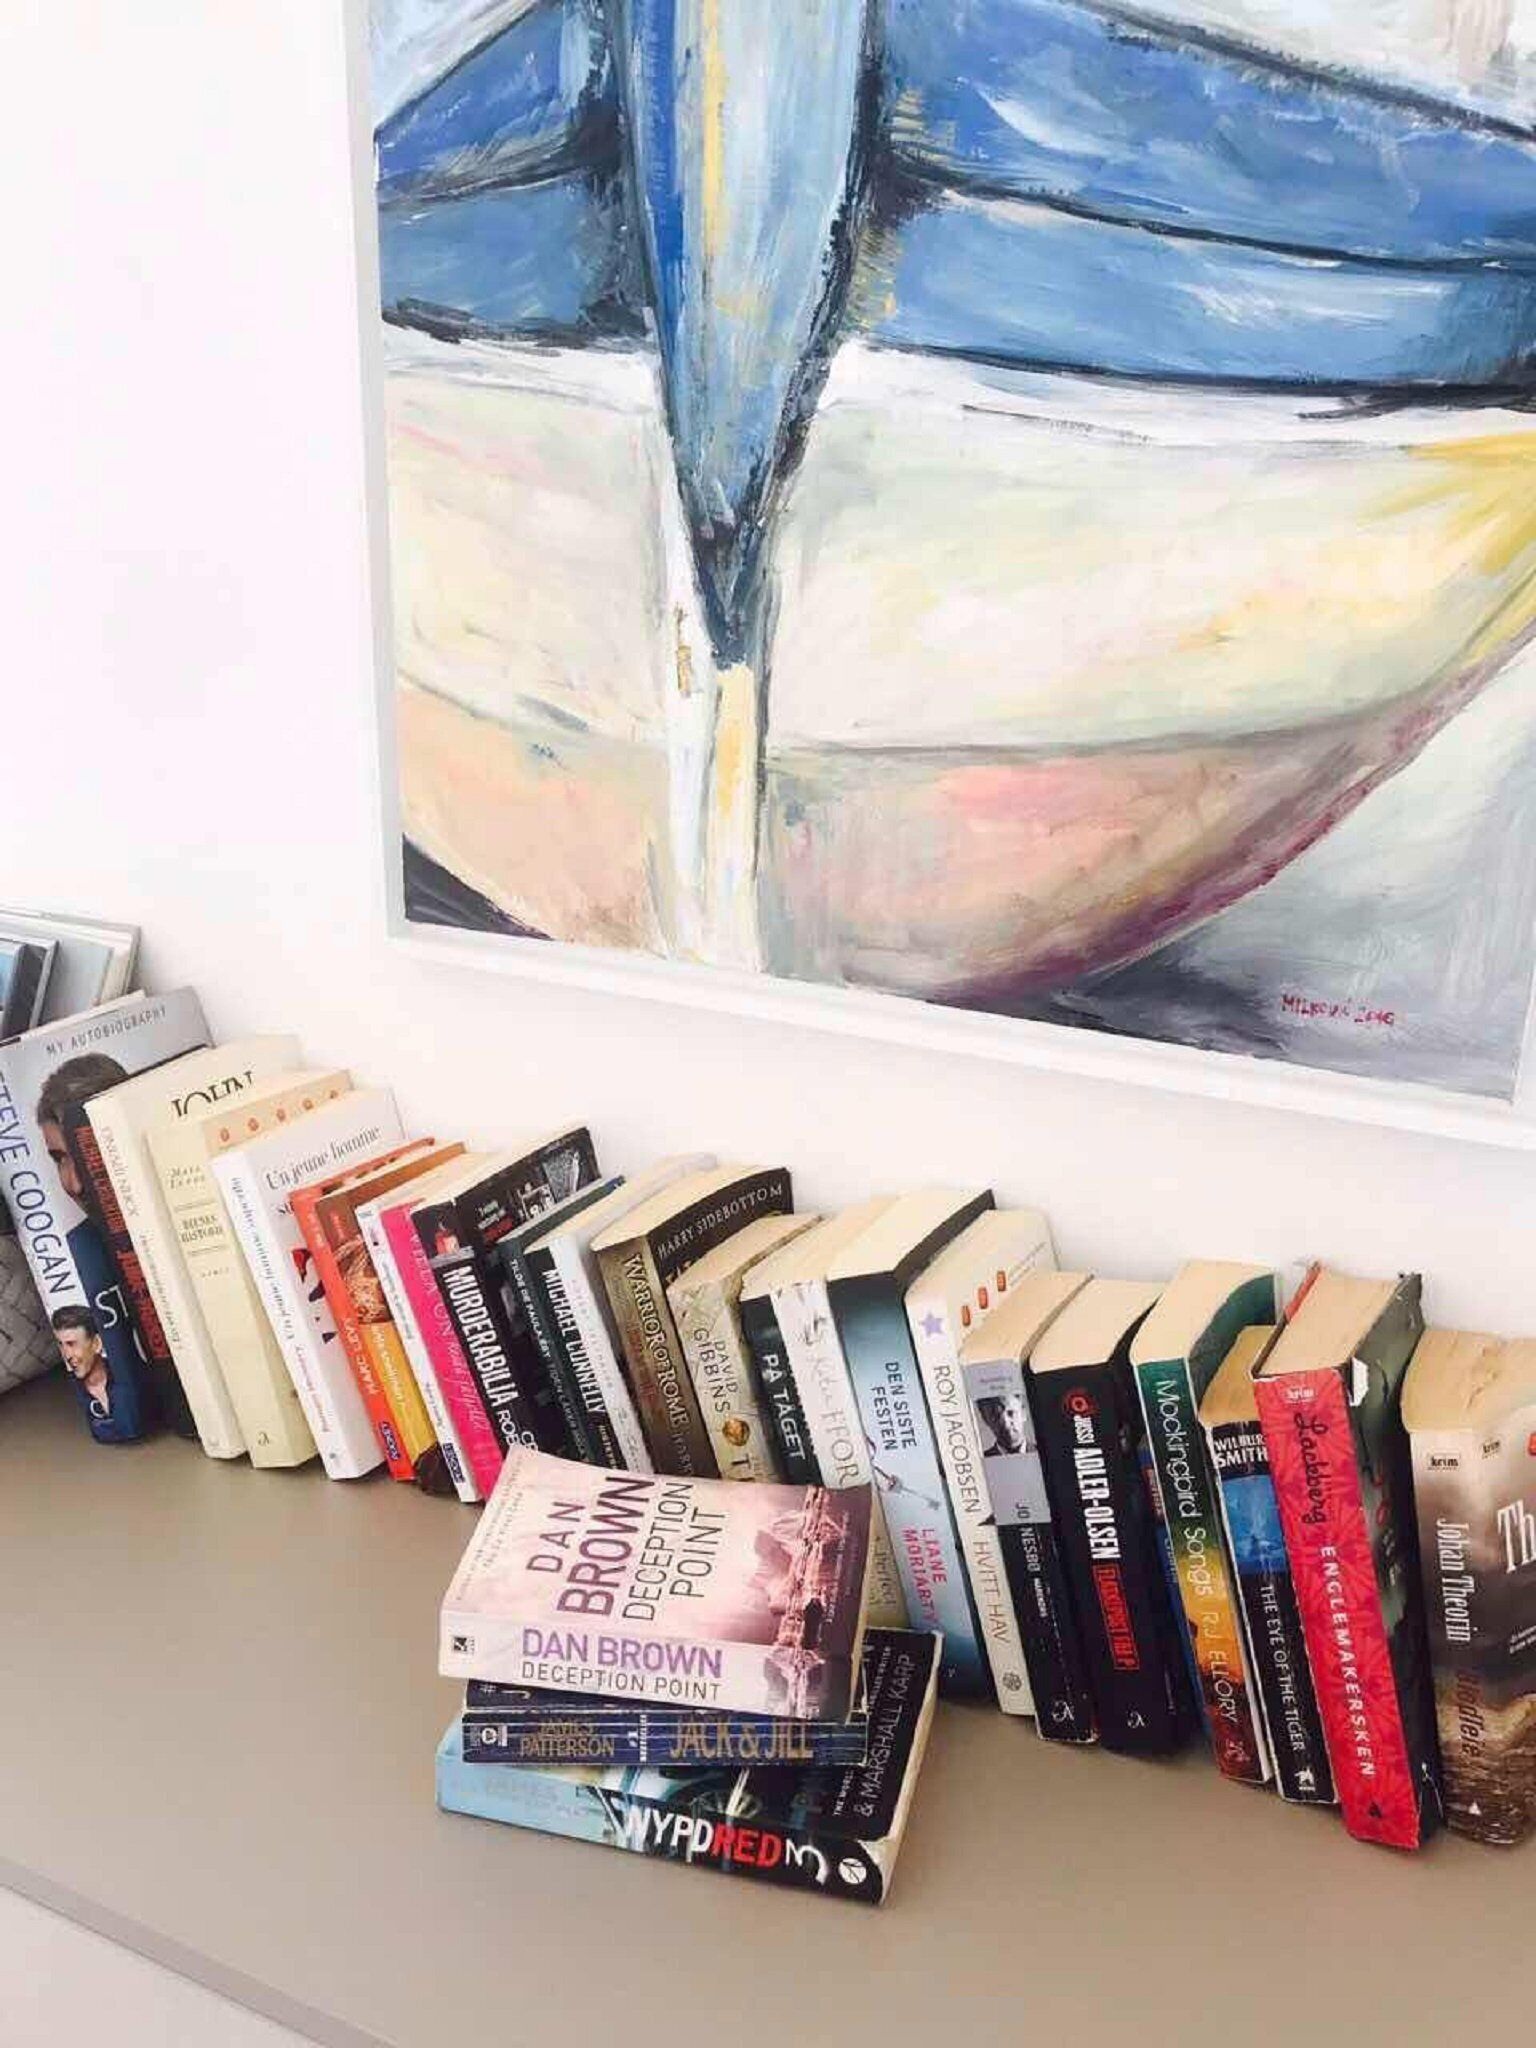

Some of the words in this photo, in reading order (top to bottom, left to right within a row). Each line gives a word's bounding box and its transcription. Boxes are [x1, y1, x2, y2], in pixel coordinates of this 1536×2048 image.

[46, 1043, 64, 1057] MY
[70, 1006, 167, 1049] AUTOBIOGRAPHY
[0, 1072, 30, 1164] TEVE
[10, 1169, 77, 1296] COOGAN
[657, 1224, 696, 1260] HARRY
[695, 1183, 783, 1235] SIDEBOTTOM
[510, 1259, 527, 1289] TILDE
[620, 1254, 667, 1351] WARRIOR
[443, 1265, 519, 1408] MURDERABILIA
[541, 1268, 574, 1338] MICHAEL
[565, 1337, 606, 1414] CONNELLY
[652, 1347, 670, 1368] OF
[693, 1327, 731, 1413] GIBBINS
[714, 1340, 738, 1394] DAVID
[885, 1361, 903, 1396] DEN
[933, 1364, 957, 1405] ROY
[657, 1366, 689, 1427] ROME
[871, 1386, 898, 1451] FESTEN
[893, 1399, 917, 1449] SISTE
[1213, 1433, 1266, 1452] WILBUR
[941, 1410, 981, 1514] JACOBSEN
[1214, 1449, 1269, 1470] SMITH
[1430, 1456, 1459, 1468] krim
[1016, 1503, 1031, 1519] JO
[1073, 1448, 1121, 1560] ADLER-OLSEN
[1154, 1380, 1203, 1518] Mockingbird
[1183, 1527, 1214, 1596] Songs
[525, 1501, 587, 1573] DAN
[556, 1476, 655, 1617] BROWN
[622, 1481, 694, 1621] DECEPTION
[669, 1506, 727, 1597] POINT
[922, 1528, 948, 1584] LIANE
[1436, 1517, 1471, 1571] Johan
[902, 1529, 939, 1626] MORIARTY
[973, 1540, 1000, 1594] HVITT
[985, 1598, 1011, 1644] HAV
[1260, 1584, 1279, 1614] THE
[1441, 1575, 1479, 1642] Theorin
[522, 1628, 589, 1662] DAN
[598, 1636, 723, 1678] BROWN
[1266, 1617, 1285, 1646] EYE
[522, 1661, 645, 1692] DECEPTION
[654, 1676, 722, 1701] POINT
[1209, 1650, 1239, 1723] ELLORY
[1273, 1650, 1290, 1673] OF
[1321, 1546, 1377, 1777] ENGLEMAKERSKEN
[1276, 1674, 1296, 1705] THE
[519, 1736, 616, 1758] PATTERSON
[540, 1717, 594, 1737] JAMES
[670, 1714, 734, 1760] JACK
[739, 1727, 763, 1760] &
[764, 1717, 814, 1760] JILL
[860, 1703, 904, 1799] MARSHALL
[889, 1653, 917, 1704] KARP
[1284, 1709, 1306, 1751] TIGER
